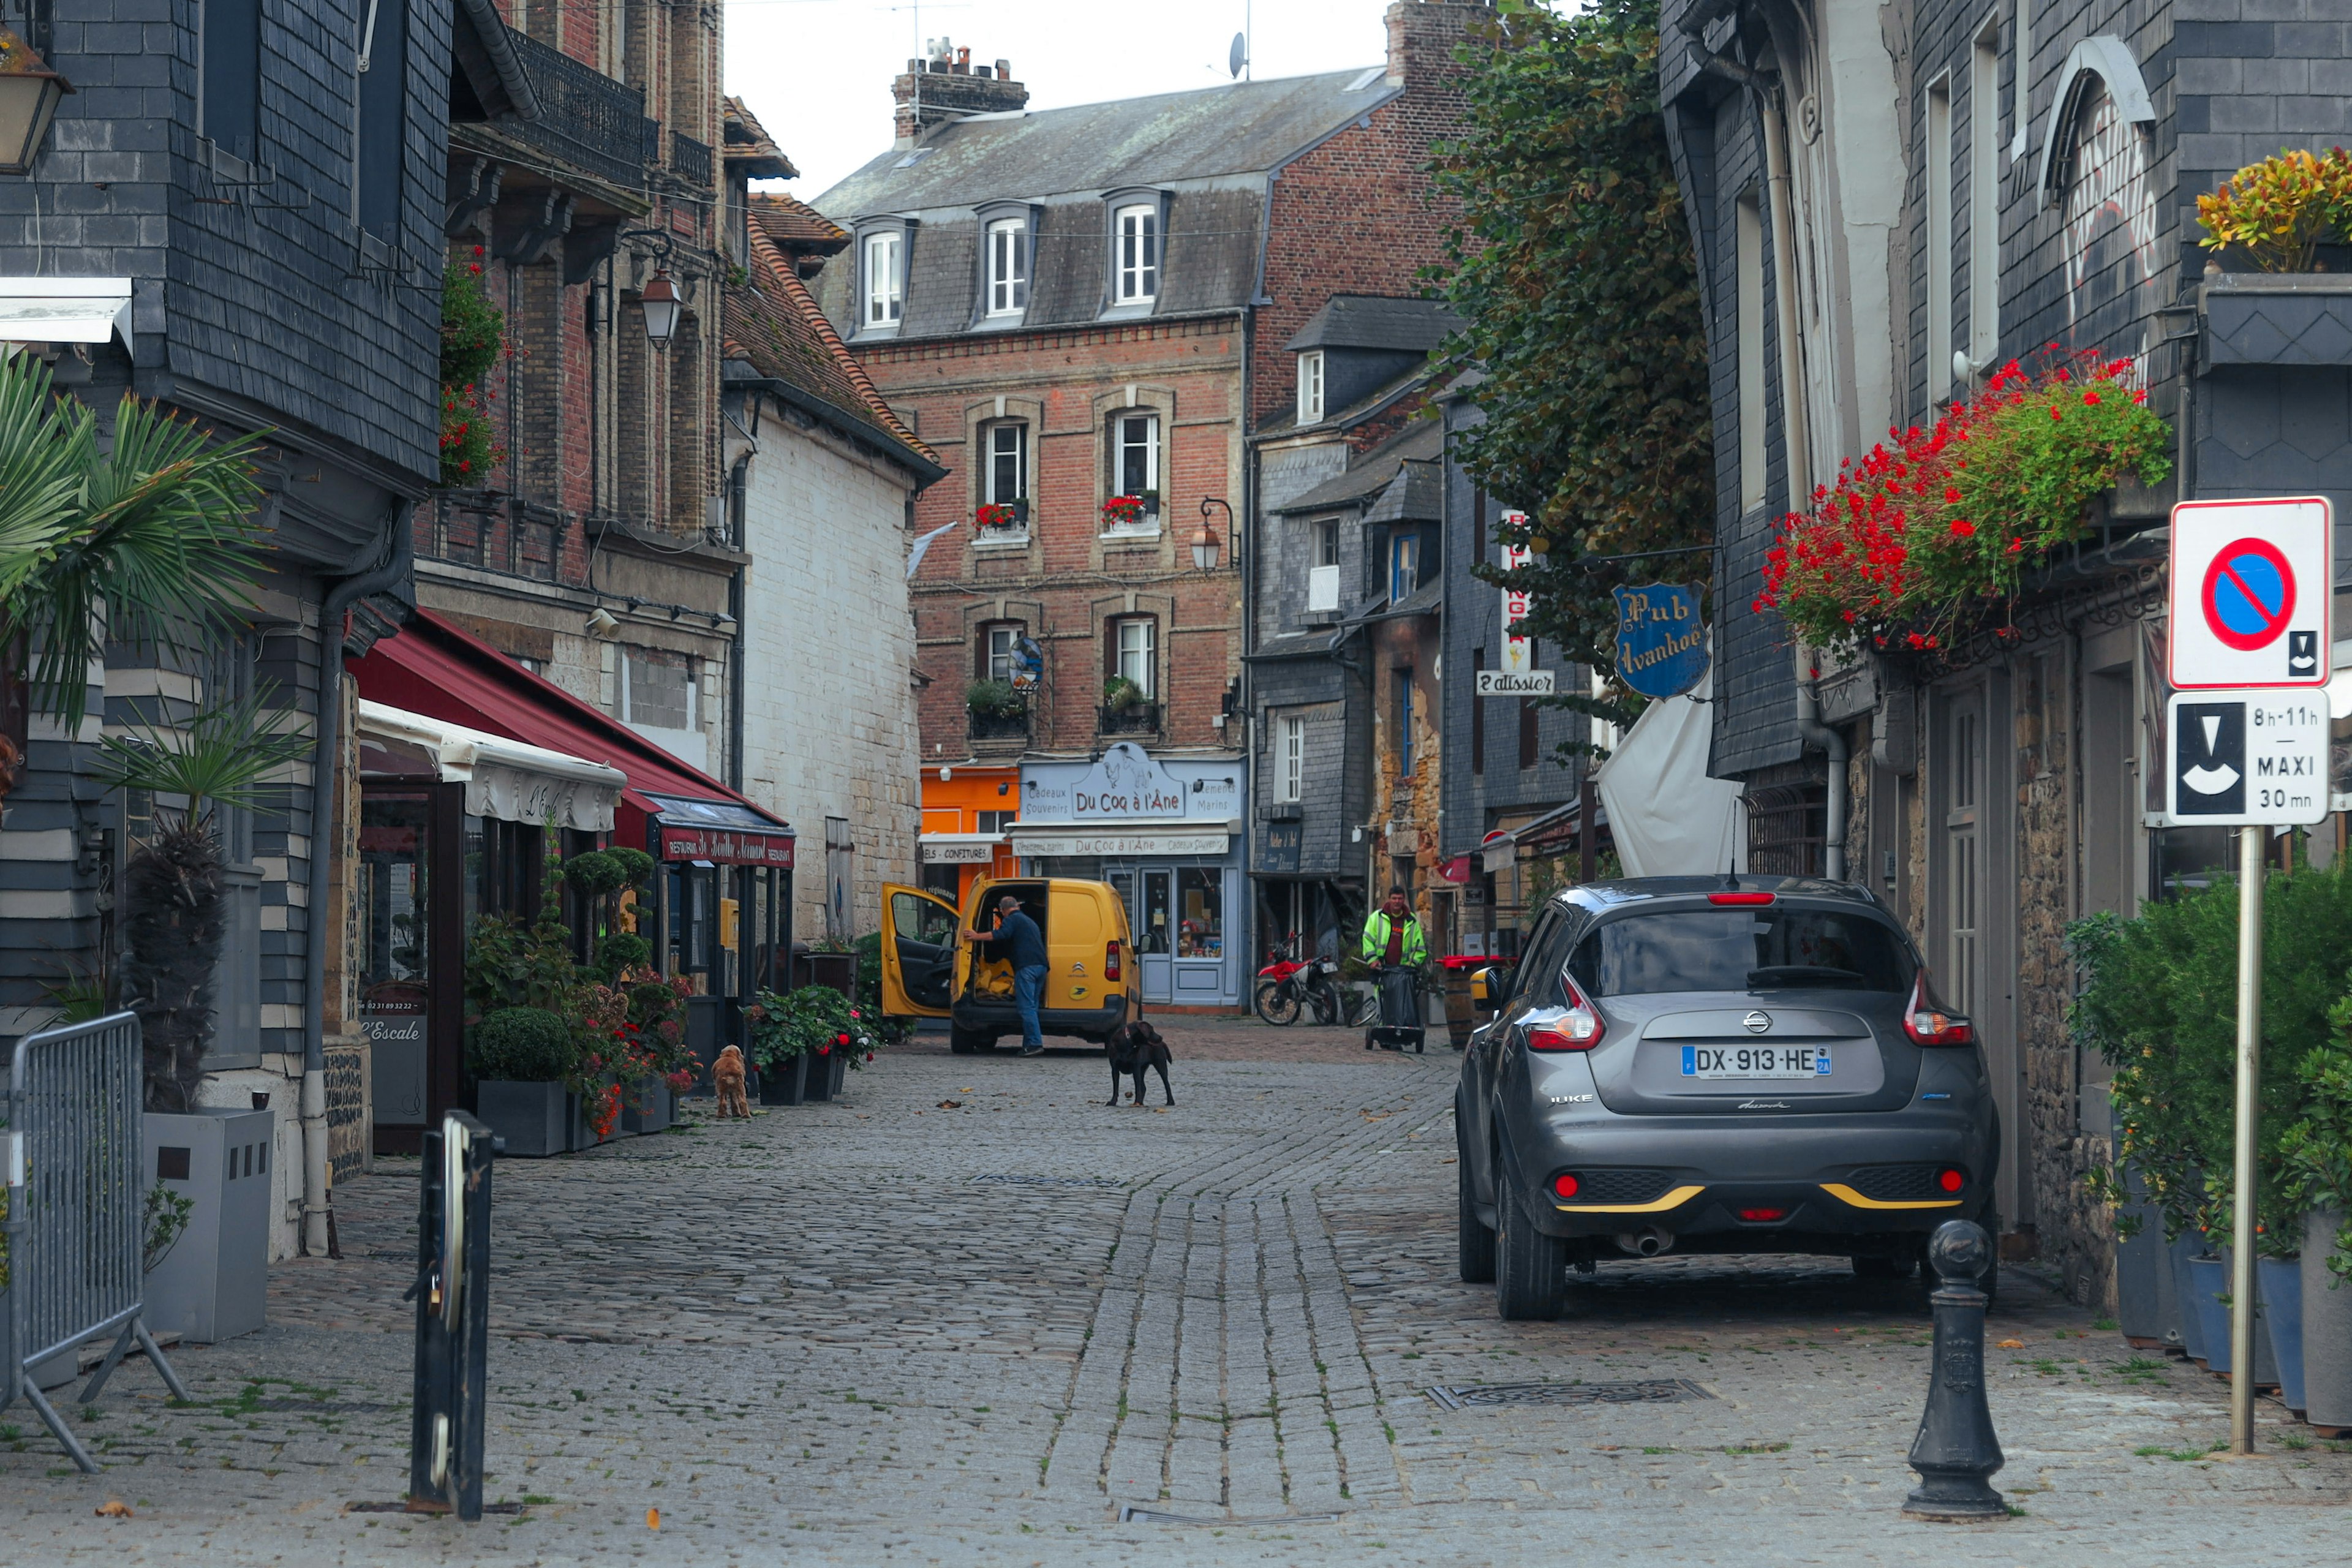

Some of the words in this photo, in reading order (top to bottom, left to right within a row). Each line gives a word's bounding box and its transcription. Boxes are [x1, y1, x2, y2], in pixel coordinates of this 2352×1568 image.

[1509, 514, 1525, 643] BULNG
[1621, 593, 1689, 632] Pub
[2258, 756, 2313, 776] MAXI
[1028, 788, 1066, 799] Cadeaux
[1189, 783, 1236, 796] Vements
[1076, 793, 1095, 812] Du
[1100, 793, 1127, 813] Coq
[1133, 791, 1140, 811] à
[1145, 788, 1179, 812] l'Âne
[2260, 789, 2285, 808] 30
[2291, 796, 2311, 807] mn
[1026, 803, 1068, 815] Souvenirs
[1197, 799, 1228, 812] Marins
[1076, 840, 1091, 853] Du
[1095, 840, 1114, 853] Coq
[1118, 838, 1125, 851] à
[1168, 840, 1193, 851] Cadeaux
[944, 848, 987, 859] CONFITURES
[1697, 1050, 1815, 1071] DX-913-HE
[1817, 1061, 1830, 1072] 2A
[1547, 1094, 1593, 1107] JUKE
